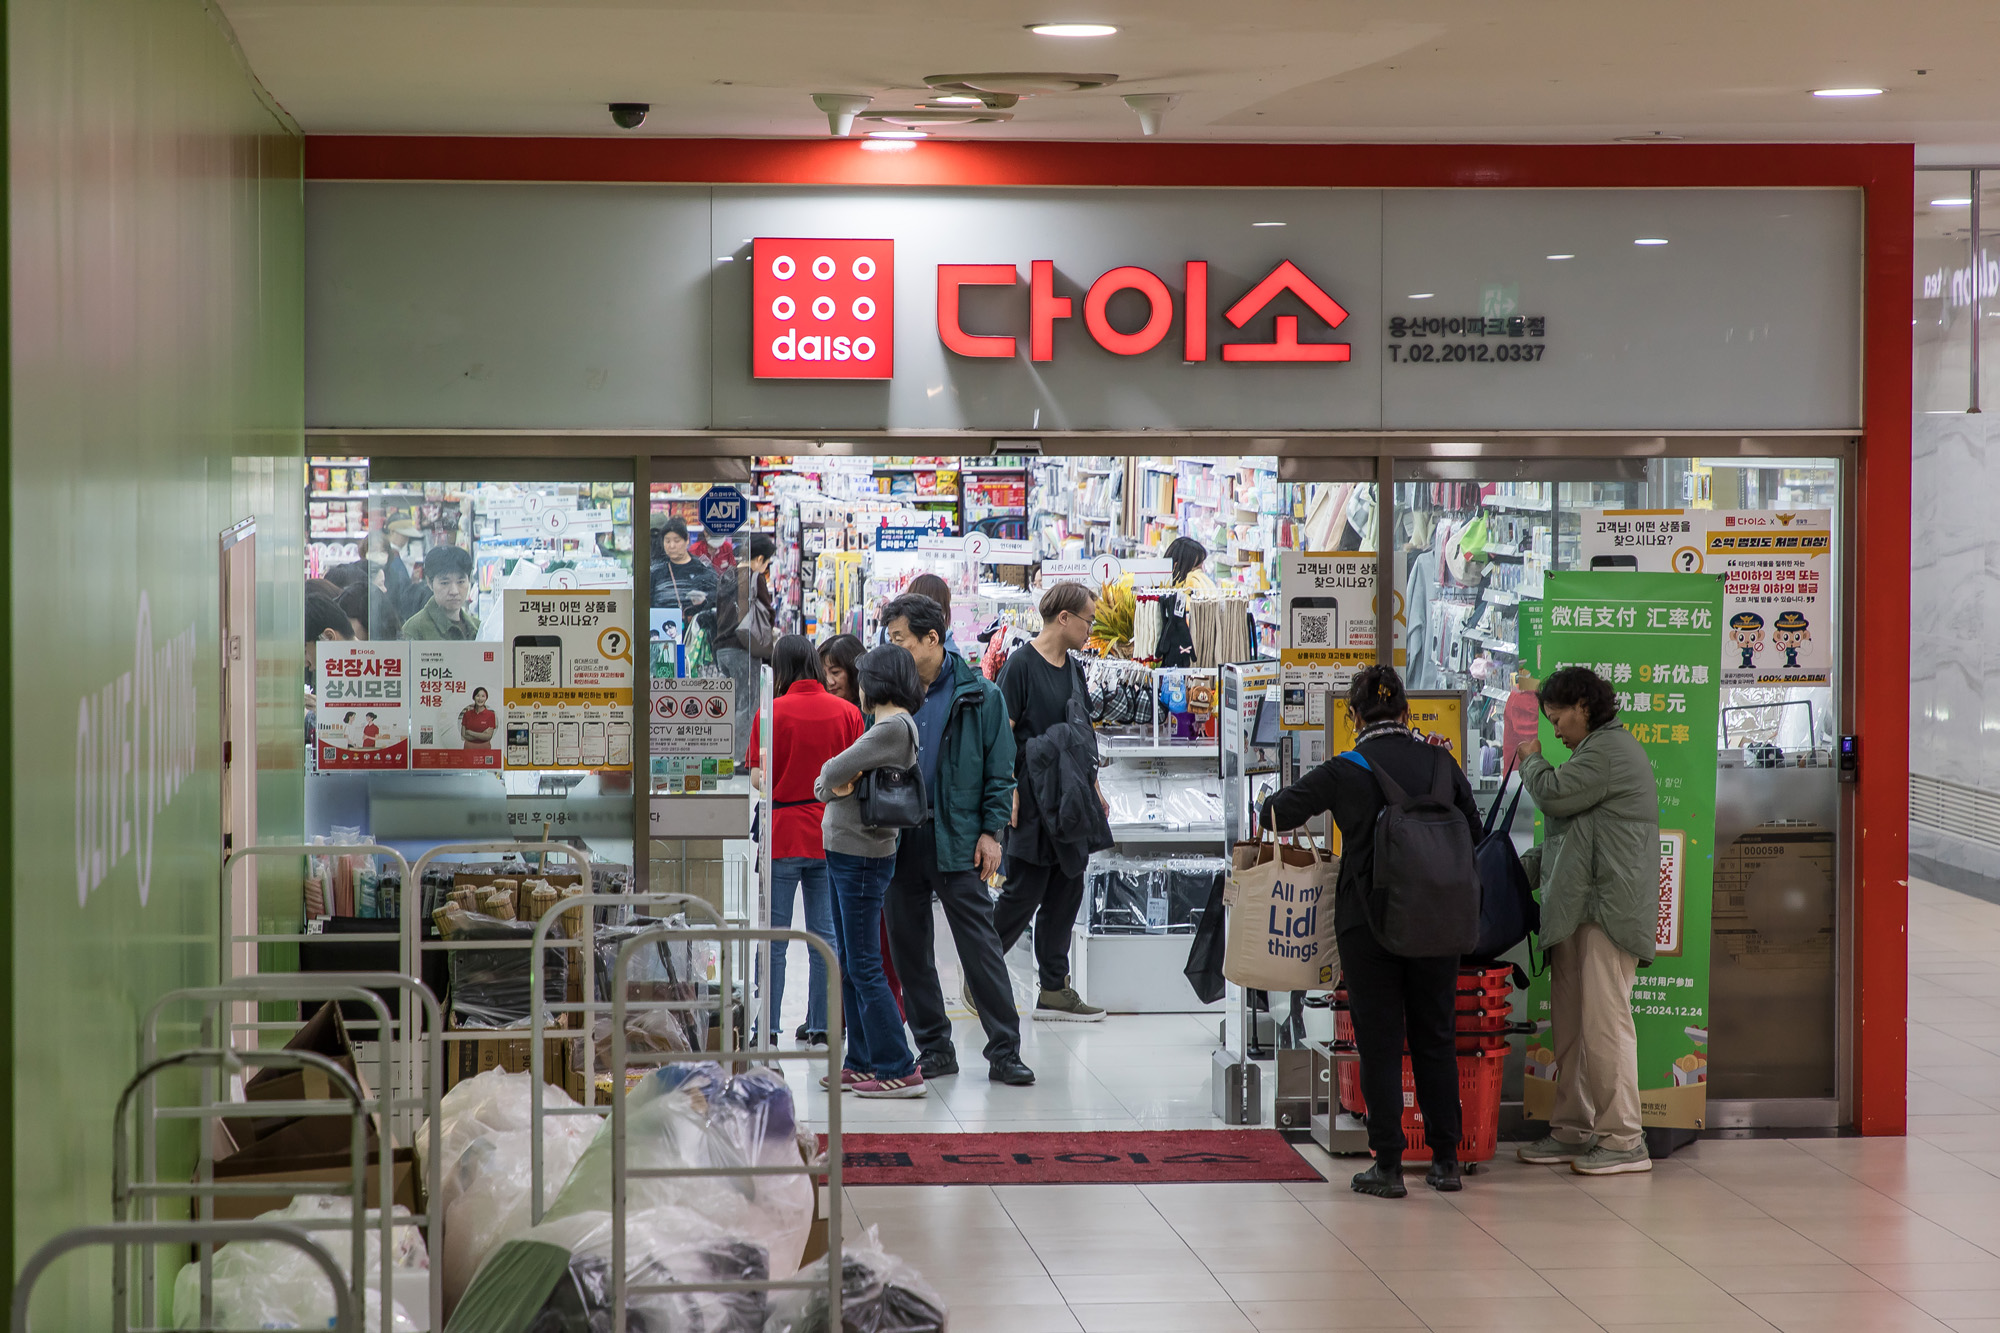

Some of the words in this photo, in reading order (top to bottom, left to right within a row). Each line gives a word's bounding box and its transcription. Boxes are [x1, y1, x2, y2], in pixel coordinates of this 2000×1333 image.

[937, 258, 1351, 362] 다이소
[772, 328, 875, 361] daiso
[1388, 344, 1545, 363] T.02.2012.0337
[530, 498, 537, 510] 7
[706, 501, 740, 519] ADT
[551, 514, 559, 527] 6
[902, 515, 908, 527] 3
[1737, 517, 1767, 526] 다이소
[1596, 521, 1632, 534] 고객님!
[1635, 521, 1656, 533] 어떤
[1659, 520, 1691, 533] 상품을
[973, 540, 982, 554] 2
[1614, 535, 1673, 547] 찾으시나요?
[1737, 537, 1772, 548] 범죄도
[1774, 537, 1798, 548] 처벌
[1801, 536, 1828, 547] 대상!
[1102, 563, 1109, 578] 1
[1297, 563, 1332, 575] 고객님!
[1335, 563, 1356, 575] 어떤
[1776, 570, 1795, 581] 징역
[1799, 570, 1819, 581] 또는
[559, 577, 568, 589] 5
[1314, 576, 1374, 588] 찾으시나요?
[1724, 583, 1760, 594] 1천만원
[1763, 583, 1794, 594] 이하의
[1798, 583, 1819, 594] 벌금
[519, 601, 555, 613] 고객님!
[560, 601, 581, 613] 어떤
[585, 601, 617, 613] 상품을
[538, 615, 599, 627] 찾으시나요?
[1551, 605, 1638, 628] 微信支付
[1647, 607, 1712, 630] 汇率优
[325, 658, 402, 677] 현장사원
[420, 667, 453, 679] 다이소
[1638, 664, 1709, 684] 9折优惠
[1757, 674, 1782, 683] 100%
[325, 680, 402, 699] 상시모집
[420, 680, 443, 693] 현장
[444, 680, 466, 693] 직원
[650, 680, 678, 690] 0:00
[702, 680, 733, 690] 22:00
[420, 695, 443, 708] 채용
[676, 726, 712, 736] 설치안내
[1665, 777, 1682, 788] 할인
[1663, 795, 1681, 806] 가능
[507, 812, 527, 824] 열린
[531, 812, 542, 823] 후
[1744, 846, 1784, 855] 0000598
[1271, 880, 1294, 902] All
[1300, 885, 1323, 904] my
[1269, 905, 1317, 938] Lidl
[1268, 937, 1318, 963] things
